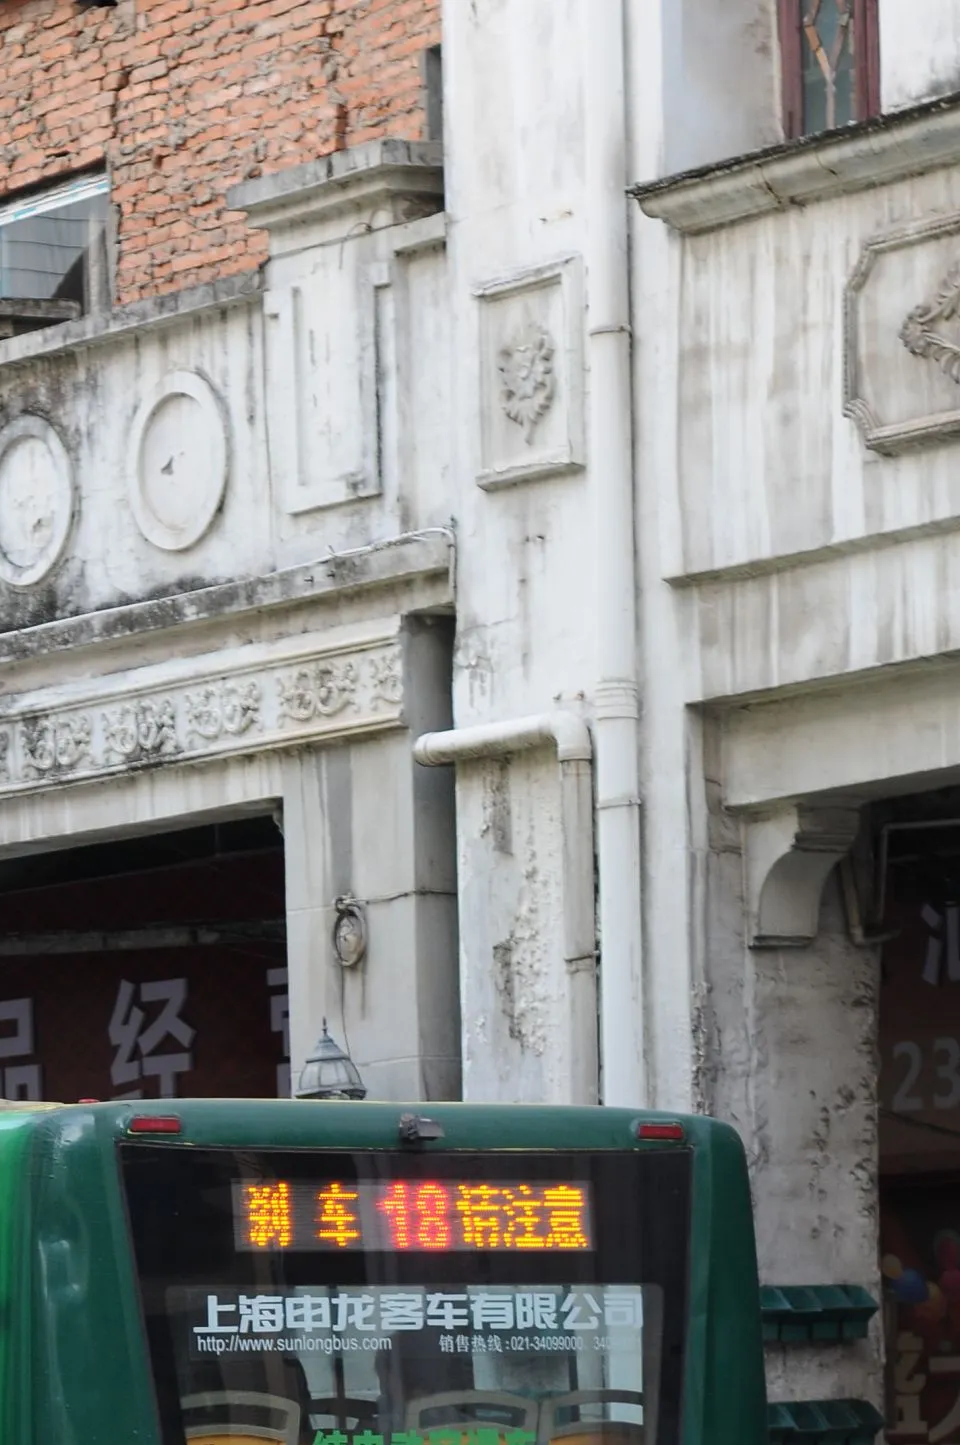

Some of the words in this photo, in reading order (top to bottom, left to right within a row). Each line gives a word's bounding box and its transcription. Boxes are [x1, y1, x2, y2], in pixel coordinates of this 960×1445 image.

[193, 1293, 643, 1333] 上海申龙客车有限公司
[197, 1336, 392, 1355] http://www.sunlongbus.com
